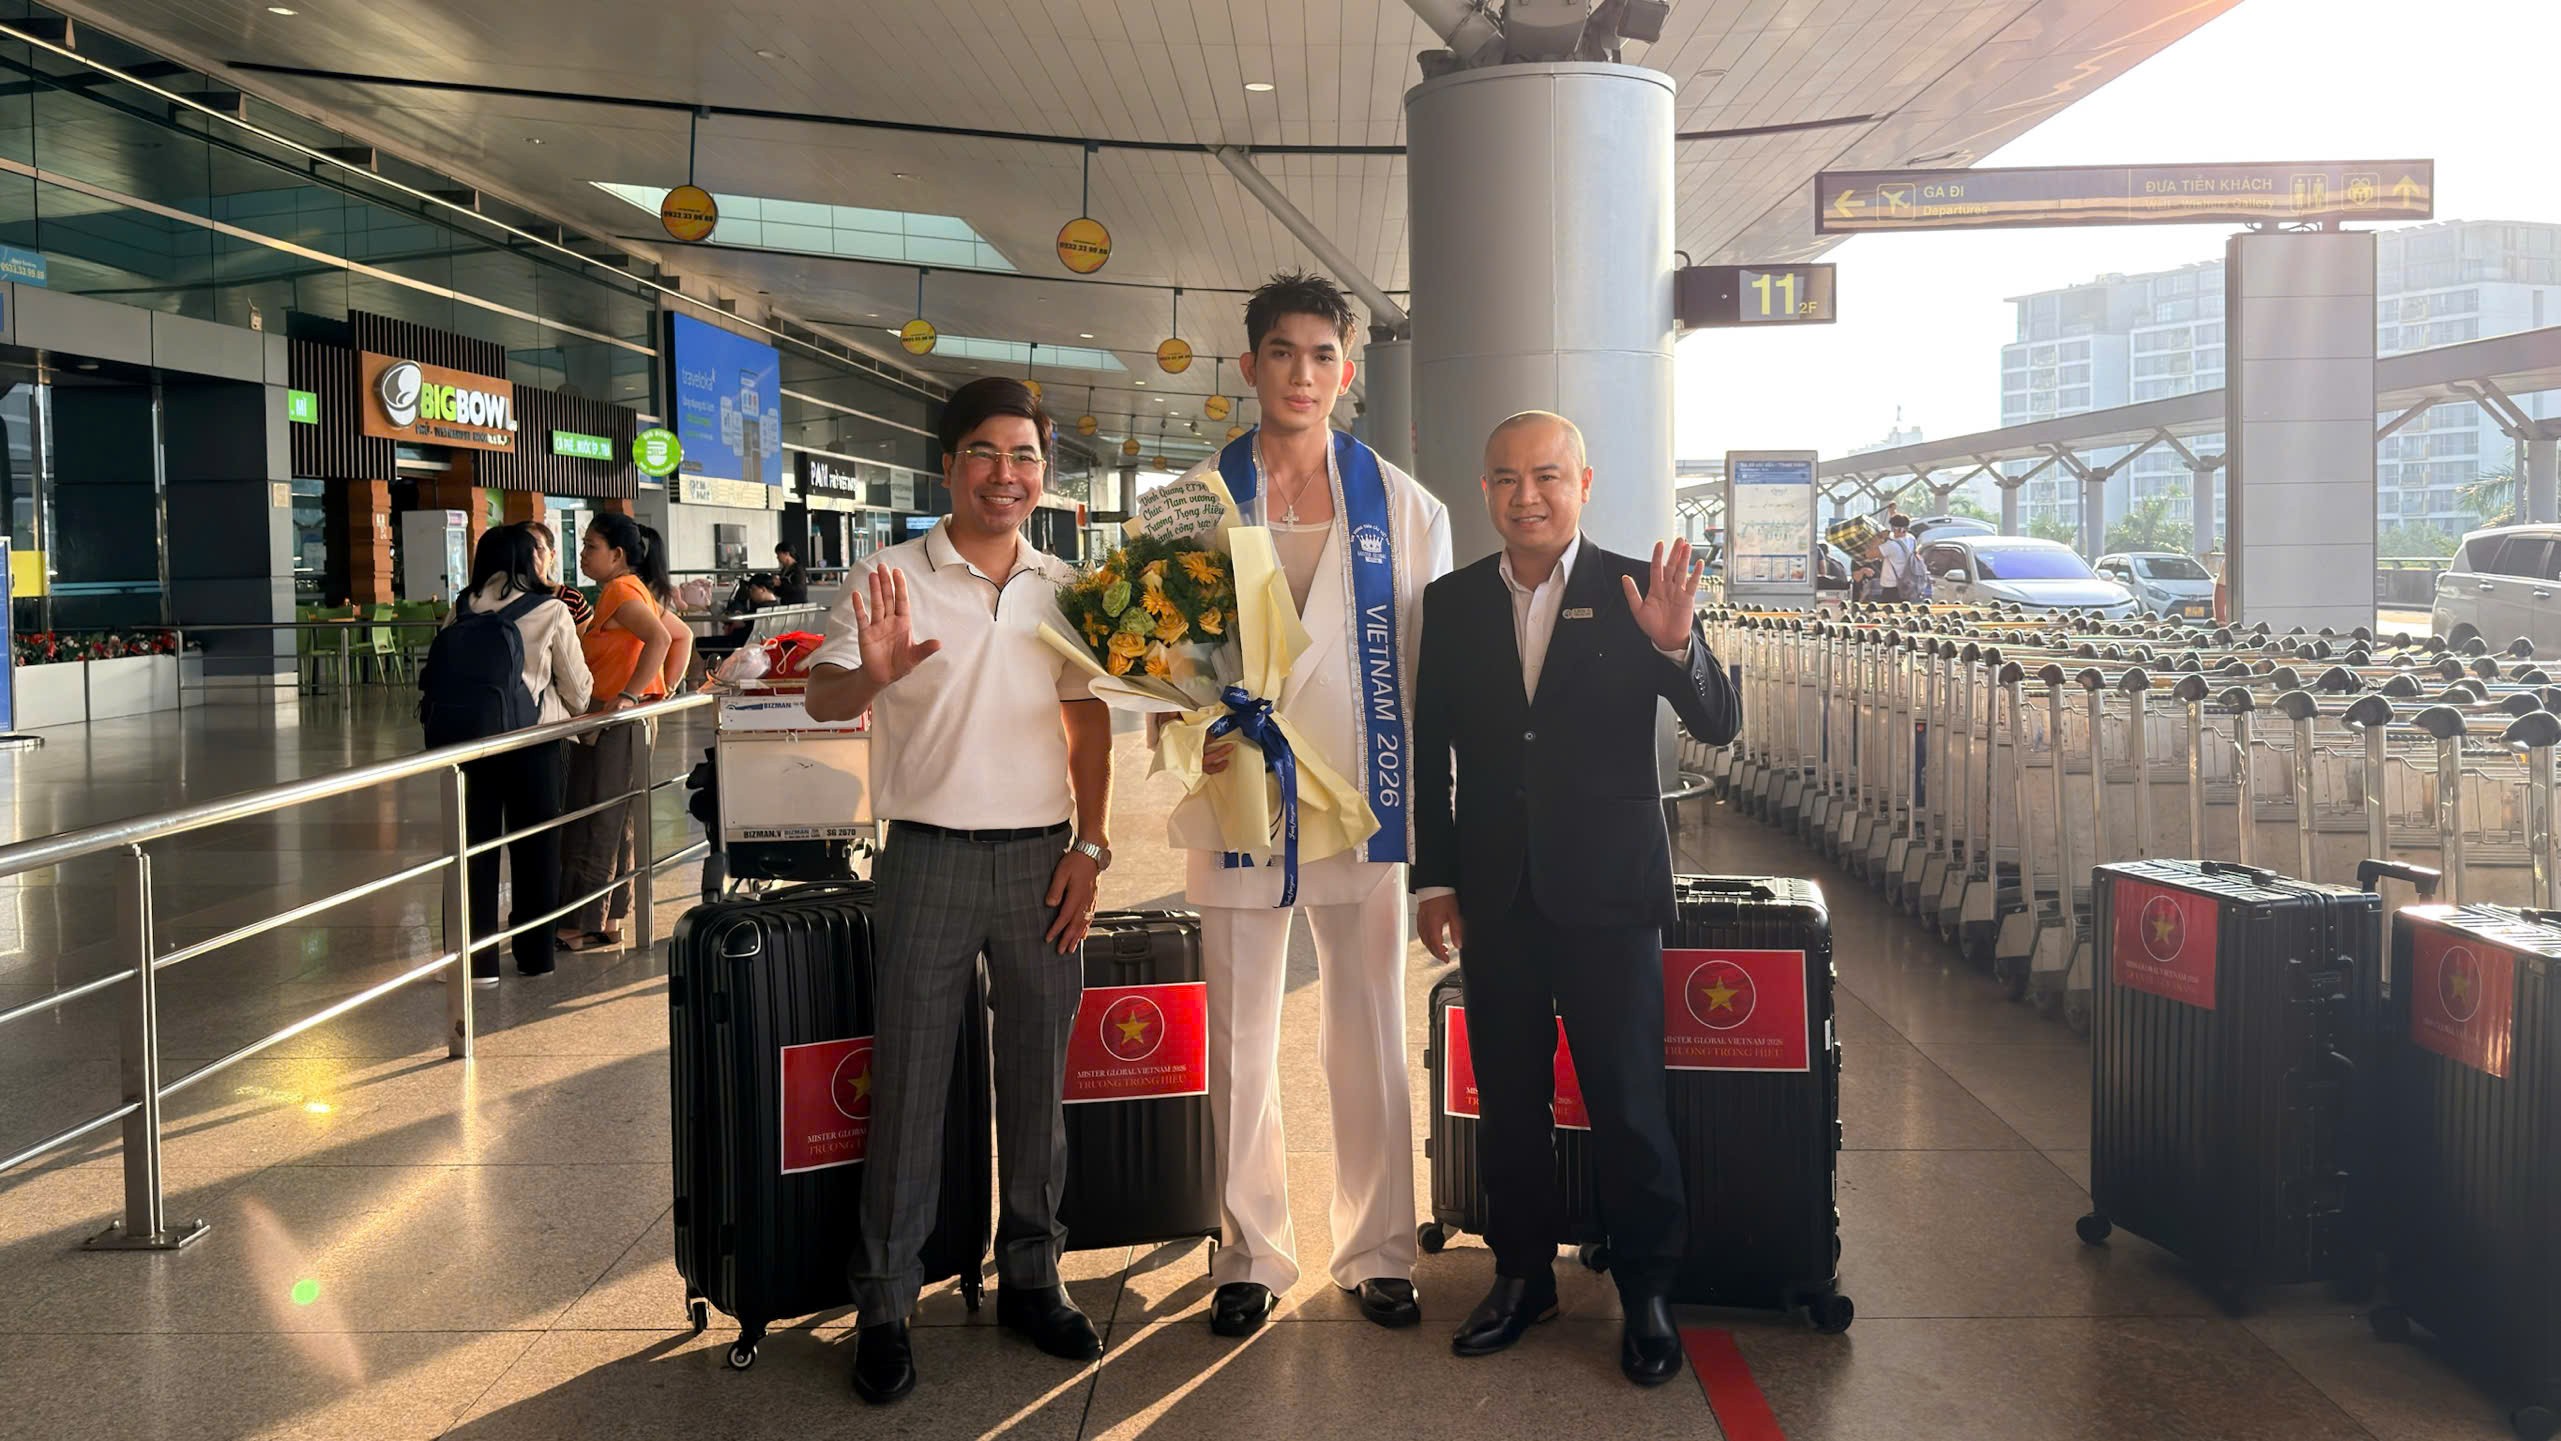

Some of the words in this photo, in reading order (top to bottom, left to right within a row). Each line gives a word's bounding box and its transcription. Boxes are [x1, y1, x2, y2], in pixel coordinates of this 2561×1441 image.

[1923, 186, 1945, 198] GA
[1950, 185, 1964, 197] ĐI
[2145, 180, 2177, 192] ĐƯA
[2220, 175, 2273, 191] KHÁCH
[1923, 205, 1989, 217] Departures
[1751, 273, 1794, 315] 11
[1799, 301, 1817, 314] 2F
[810, 461, 829, 488] PAN
[1141, 492, 1159, 507] Vinh
[1159, 486, 1184, 498] Quang
[1143, 505, 1163, 521] Chúc
[1164, 497, 1187, 510] Nam
[1174, 508, 1200, 520] Trọng
[1202, 503, 1224, 515] Hiếu
[1174, 522, 1194, 533] công
[1366, 604, 1397, 721] VIETNAM
[763, 702, 792, 710] BIZMAN
[1377, 732, 1400, 808] 2026
[826, 829, 837, 837] SG
[1694, 1036, 1725, 1046] GLOBAL
[1727, 1038, 1766, 1046] VIETNAM
[1077, 1069, 1106, 1079] MISTER
[1106, 1067, 1136, 1077] GLOBAL
[1137, 1065, 1172, 1075] VIETNAM
[807, 1131, 837, 1143] MISTER
[838, 1127, 867, 1139] GLOBA
